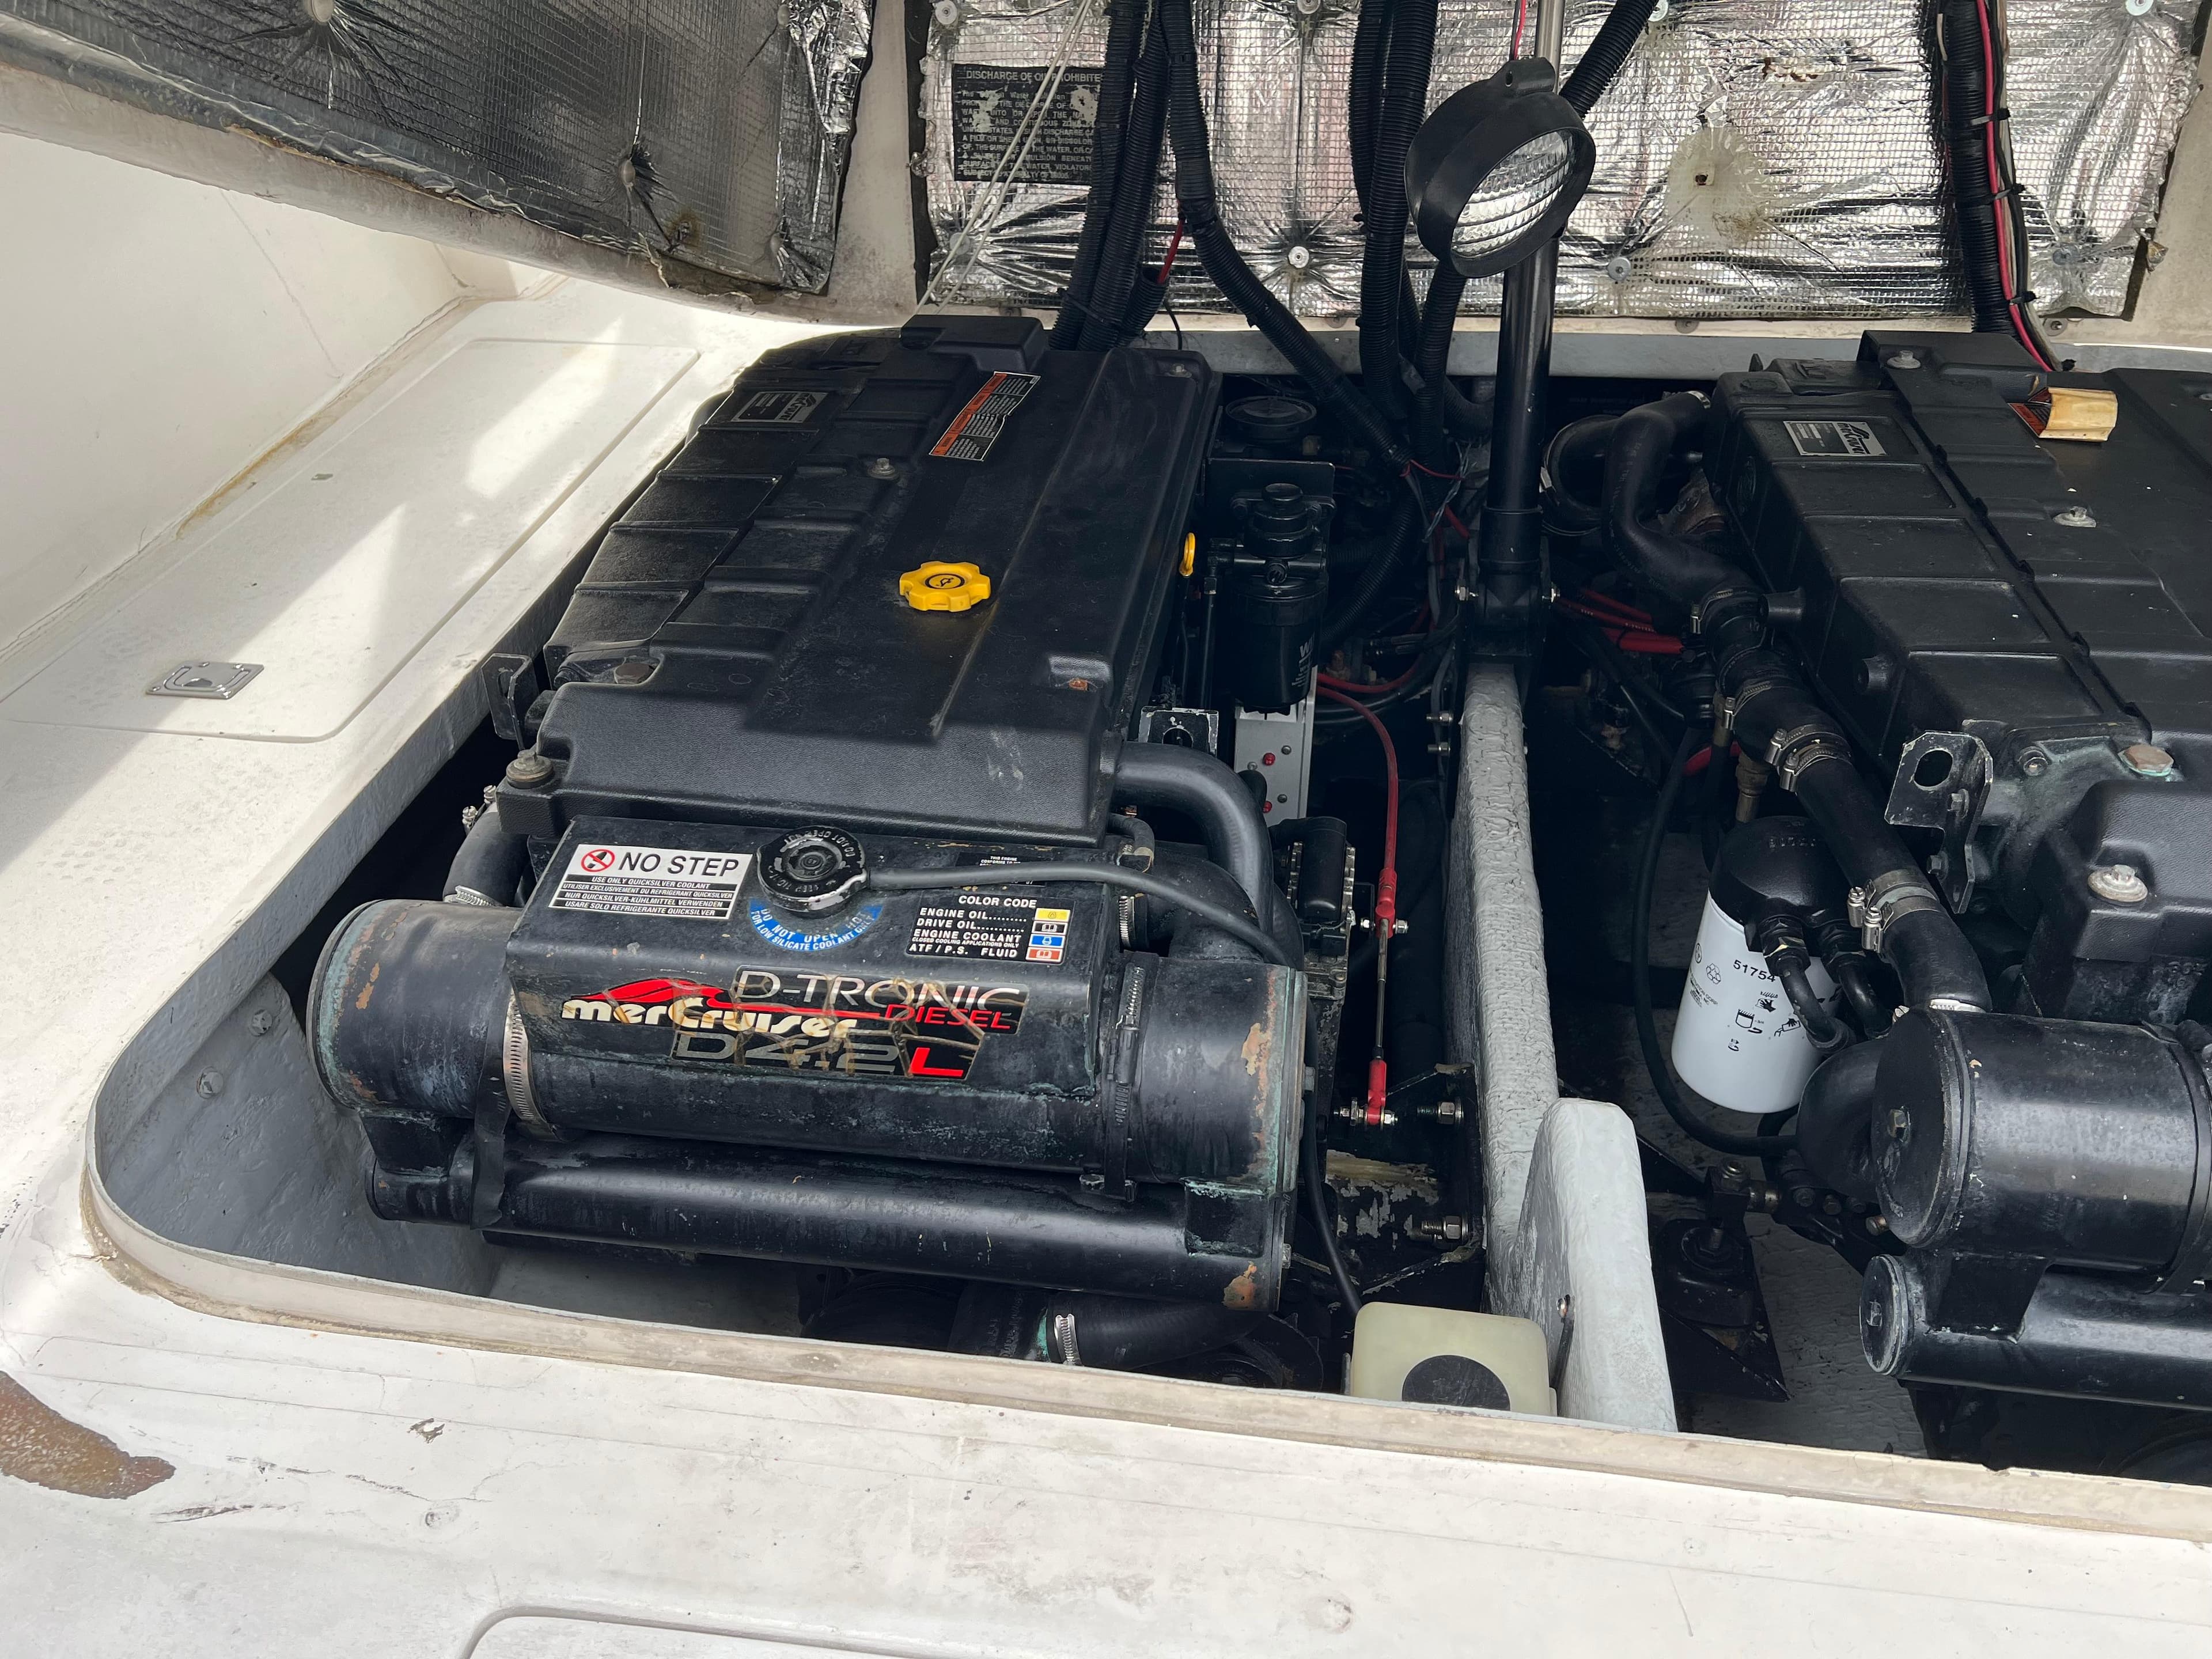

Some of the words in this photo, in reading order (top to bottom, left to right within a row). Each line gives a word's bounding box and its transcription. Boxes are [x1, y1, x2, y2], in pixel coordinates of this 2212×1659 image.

[966, 70, 1017, 81] DISCHARGE
[1021, 72, 1033, 81] OF
[1035, 73, 1047, 81] OI
[1051, 73, 1101, 82] POHIBITE
[1015, 101, 1054, 109] DISCARE
[618, 851, 661, 872] NO
[667, 854, 740, 877] STEP
[592, 876, 607, 884] USE
[607, 877, 627, 885] ONLY
[628, 878, 676, 888] QUICKSILVER
[677, 881, 711, 889] COOLANT
[563, 883, 590, 891] UTILISER
[590, 884, 640, 895] EXCLUSIVEMENT
[650, 888, 692, 897] REFRIGERANT
[693, 891, 733, 899] QUICKSILVER
[581, 893, 676, 906] QUICKSILVER-KÜHLMITTEL
[677, 899, 724, 908] VERWENDEN
[958, 895, 1000, 907] COLOR
[1003, 897, 1037, 908] CODE
[590, 902, 611, 910] SOLO
[610, 903, 666, 915] REFRIGERANTE
[667, 907, 716, 916] QUICKSILVER
[919, 907, 965, 919] ENGINE
[751, 910, 763, 926] FOR
[757, 923, 774, 940] LOW
[771, 935, 811, 951] SILICATE
[812, 933, 854, 951] COOLANT
[916, 918, 953, 929] DRIVE
[771, 923, 796, 940] NOT
[914, 929, 960, 940] ENGINE
[963, 931, 1022, 944] COOLANT
[909, 944, 932, 953] ATF
[935, 945, 942, 953] /
[944, 946, 969, 955] P.S.
[981, 948, 1018, 958] FLUID
[962, 940, 1003, 948] APPLICATIONS
[1733, 959, 1776, 983] 51754
[736, 970, 1022, 1013] D-TRONIC
[561, 997, 858, 1039] merCruiser
[885, 1003, 1013, 1029] DIESEL
